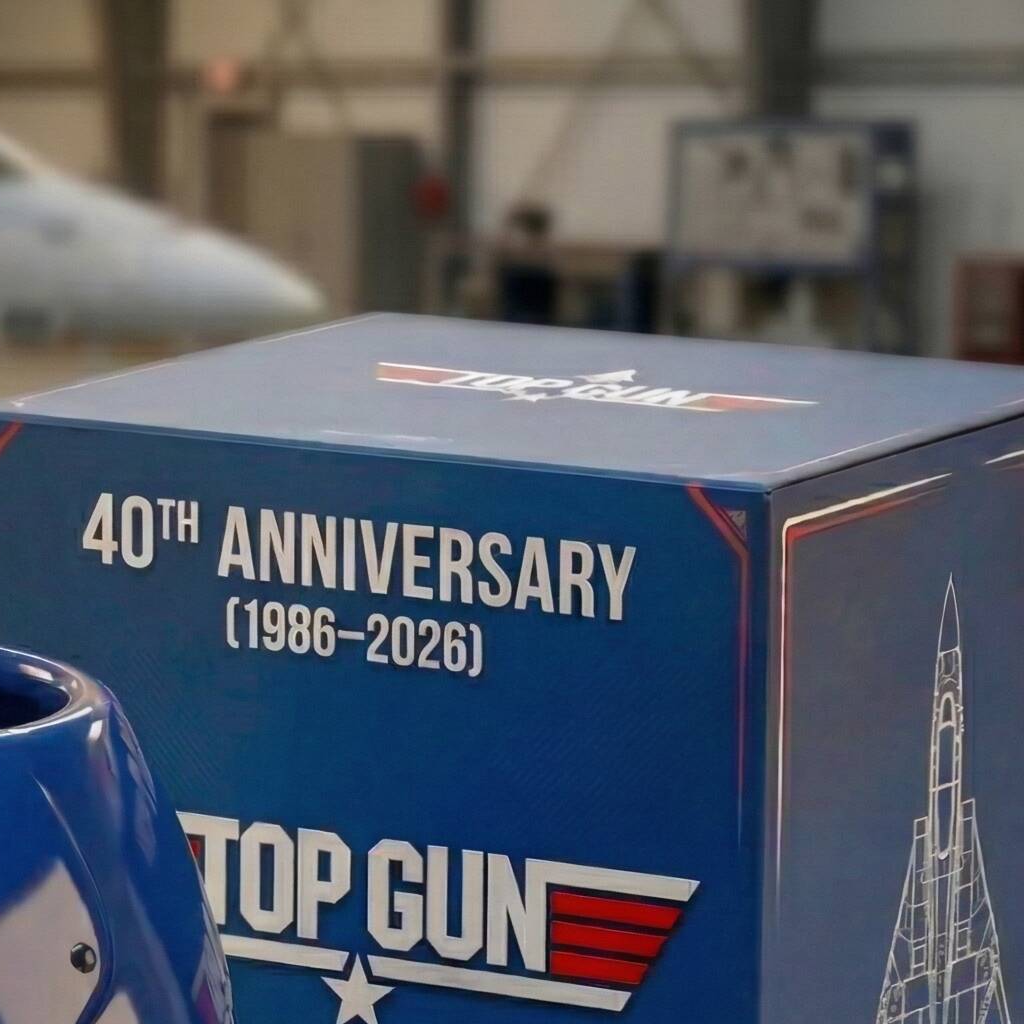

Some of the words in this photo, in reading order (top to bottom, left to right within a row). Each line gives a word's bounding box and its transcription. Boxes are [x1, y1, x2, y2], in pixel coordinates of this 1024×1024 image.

[81, 492, 199, 569] 40TH
[216, 505, 637, 621] ANNIVERSARY
[176, 811, 352, 939] TOP
[367, 838, 547, 973] GUN
